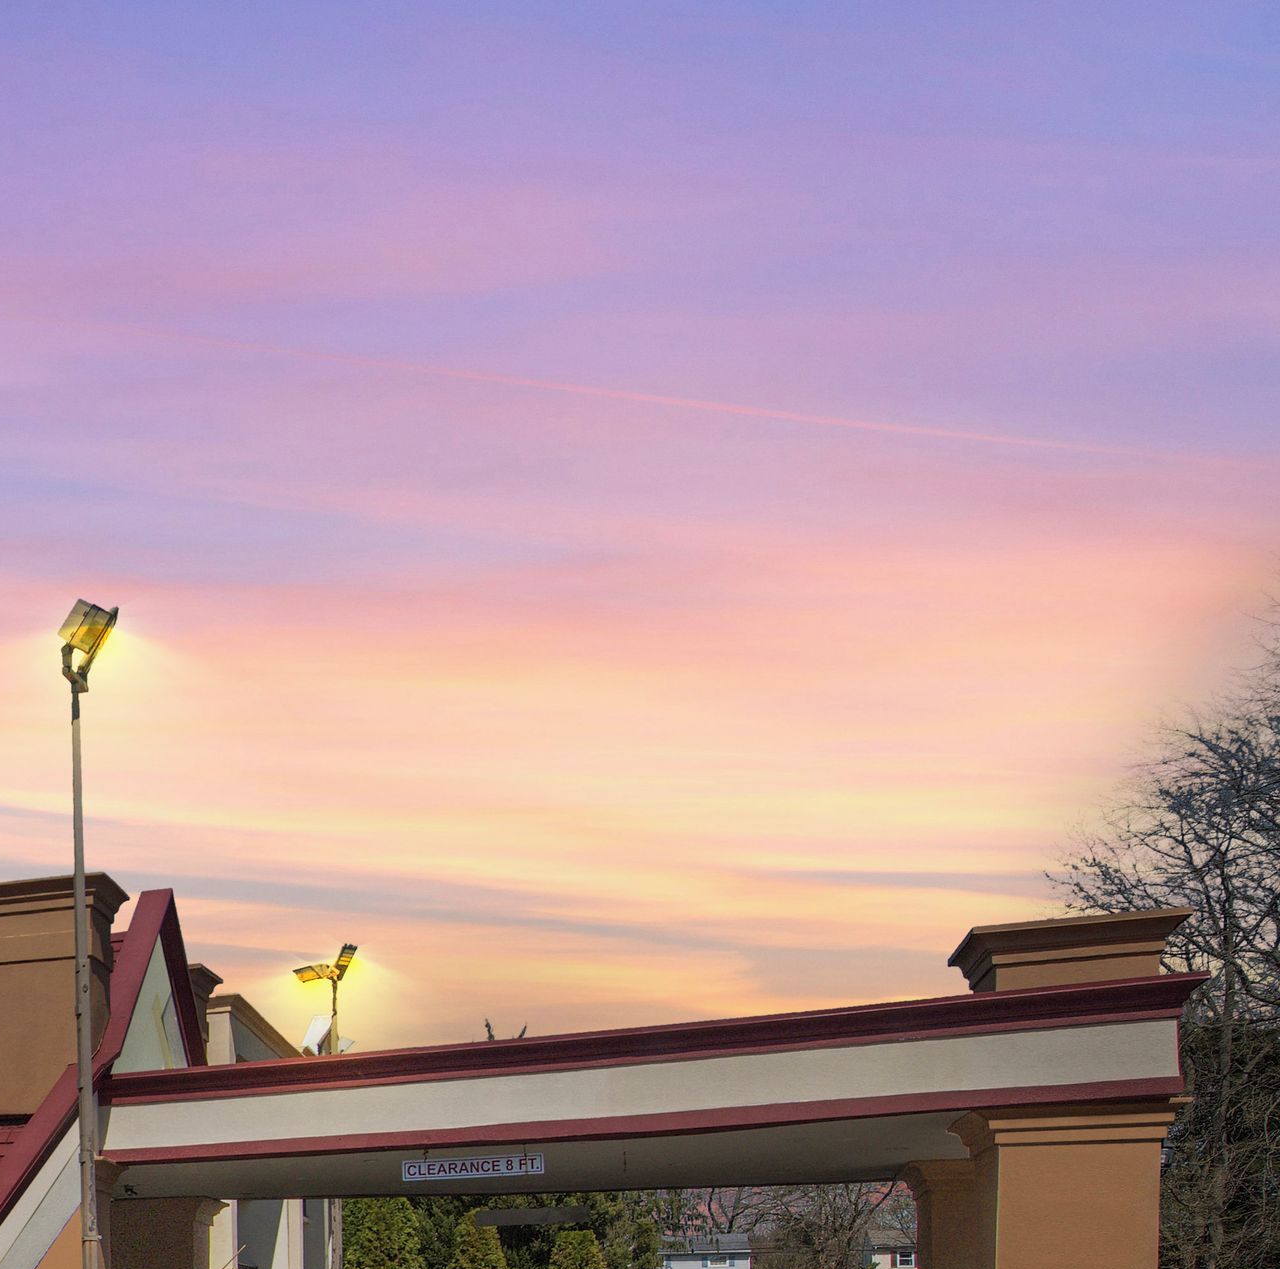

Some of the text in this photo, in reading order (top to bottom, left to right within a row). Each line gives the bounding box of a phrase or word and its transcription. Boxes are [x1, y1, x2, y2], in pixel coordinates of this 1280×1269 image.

[407, 1157, 540, 1176] CLEARANCE 8 FT.
